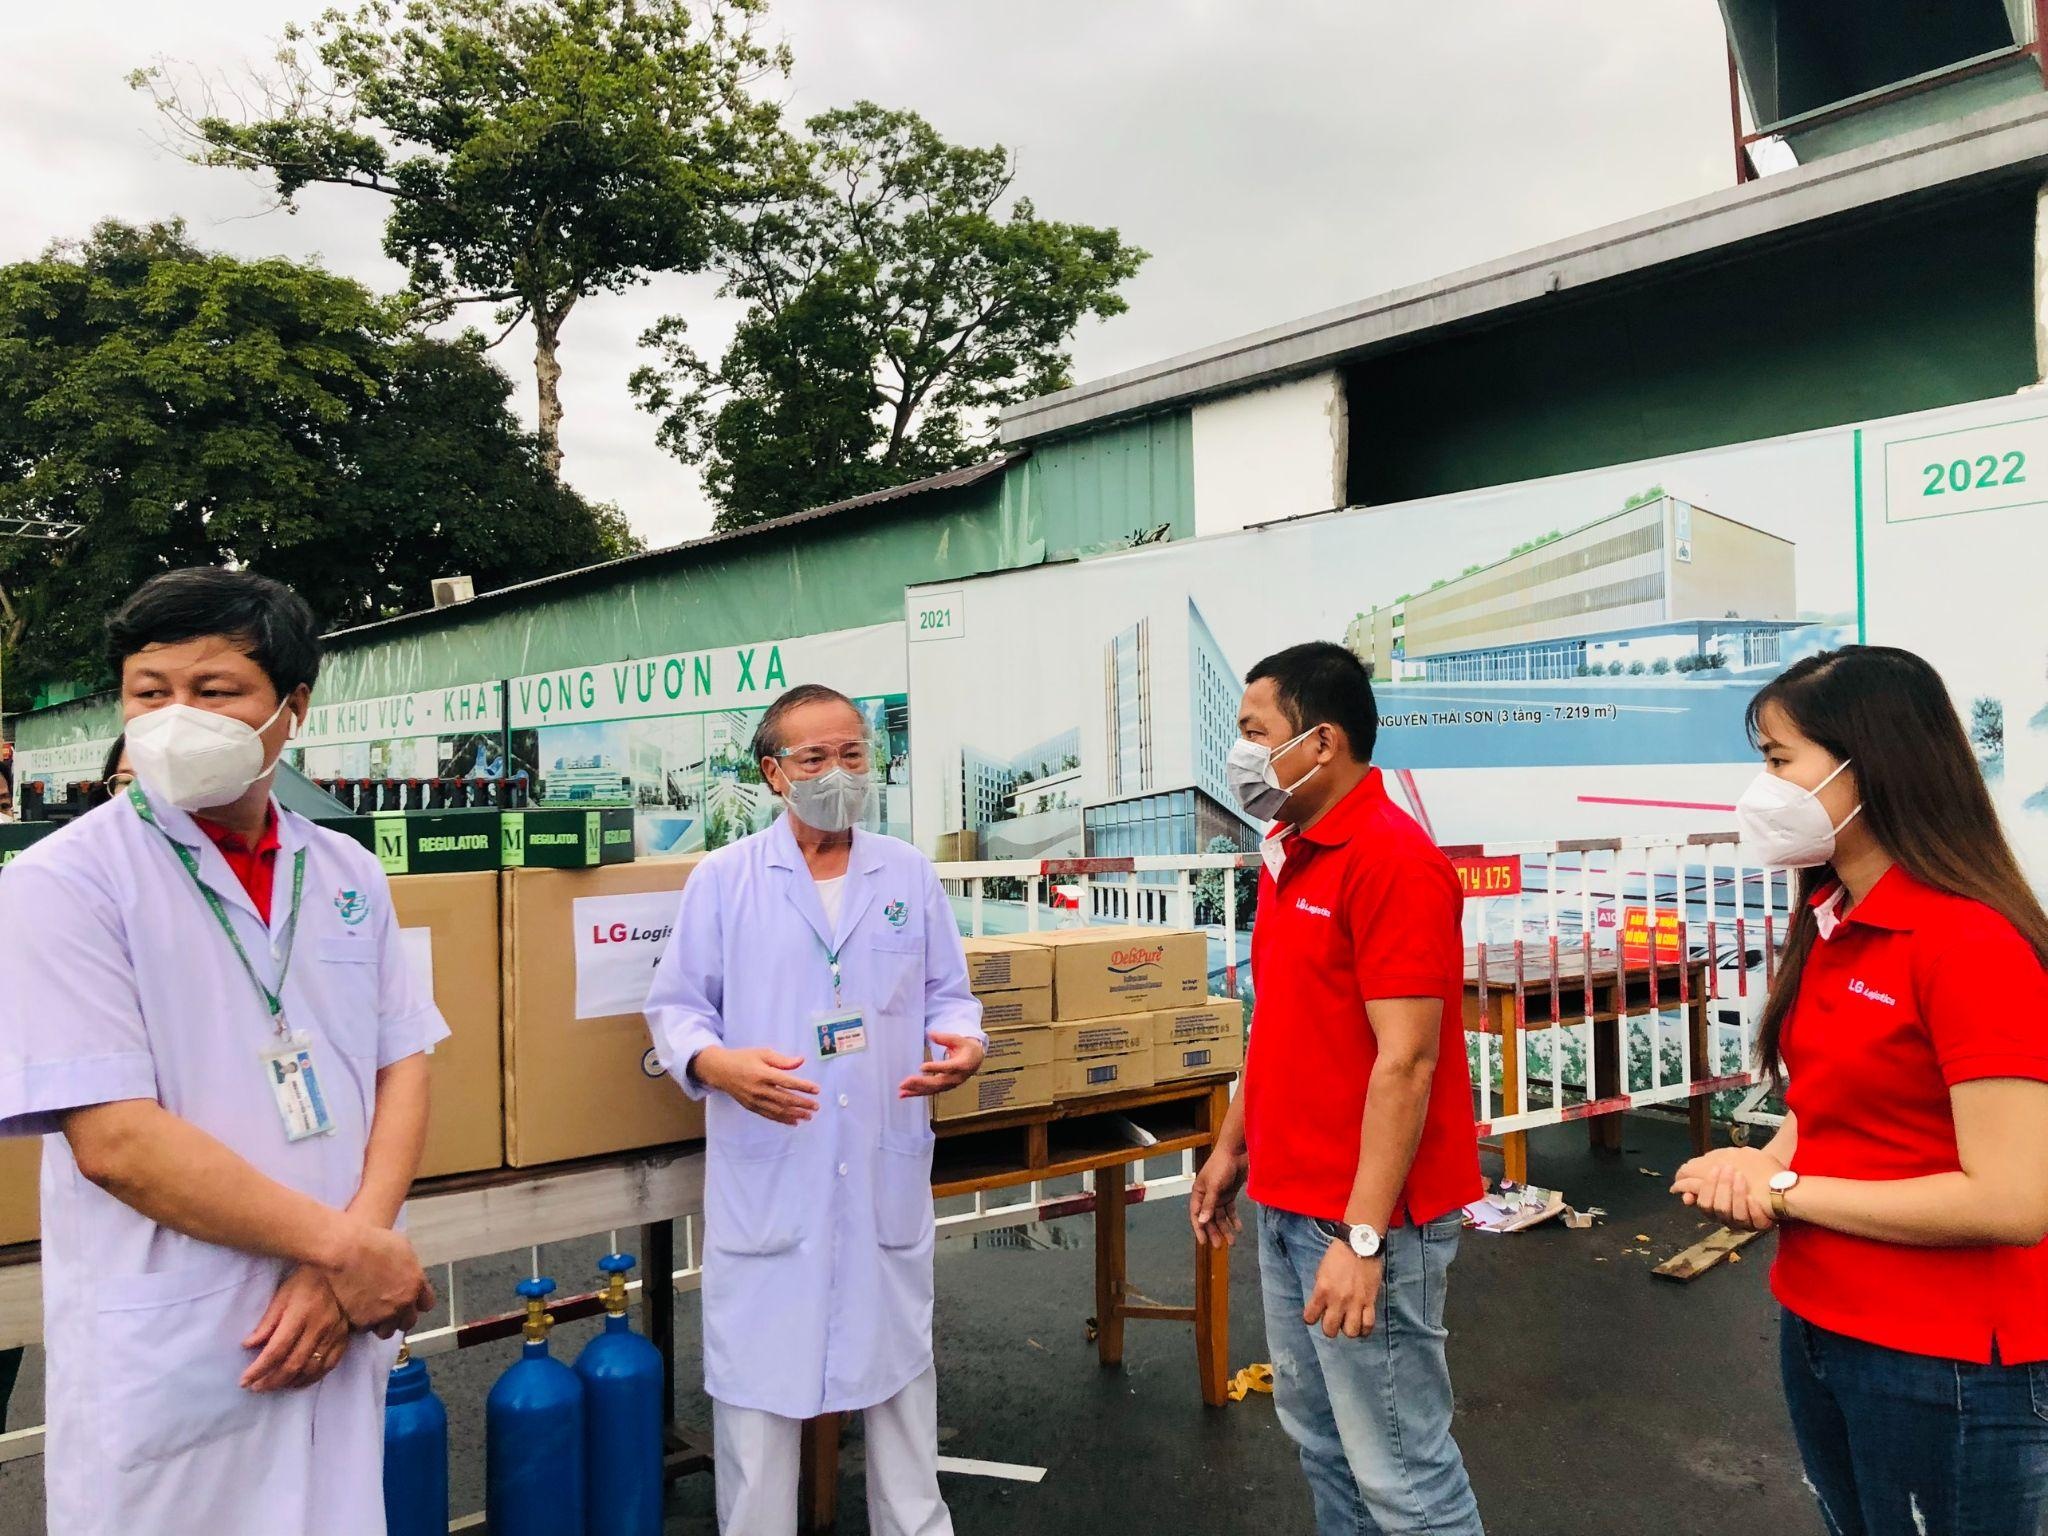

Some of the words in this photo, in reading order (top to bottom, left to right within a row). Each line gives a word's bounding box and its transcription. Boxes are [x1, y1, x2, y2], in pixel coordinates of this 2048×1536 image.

[1923, 450, 2026, 496] 2022
[920, 608, 951, 630] 2021
[337, 703, 368, 733] KHU
[519, 671, 595, 722] VỌNG
[613, 655, 711, 704] VƯƠN
[736, 645, 787, 693] XA
[1464, 710, 1493, 724] SƠN
[1554, 707, 1590, 720] 7.219
[381, 836, 402, 857] M
[419, 835, 488, 852] REGULATOR
[503, 829, 522, 850] M
[529, 834, 579, 845] REGULATOR
[1485, 866, 1511, 889] 175
[593, 923, 627, 944] LG
[1848, 978, 1864, 994] LG
